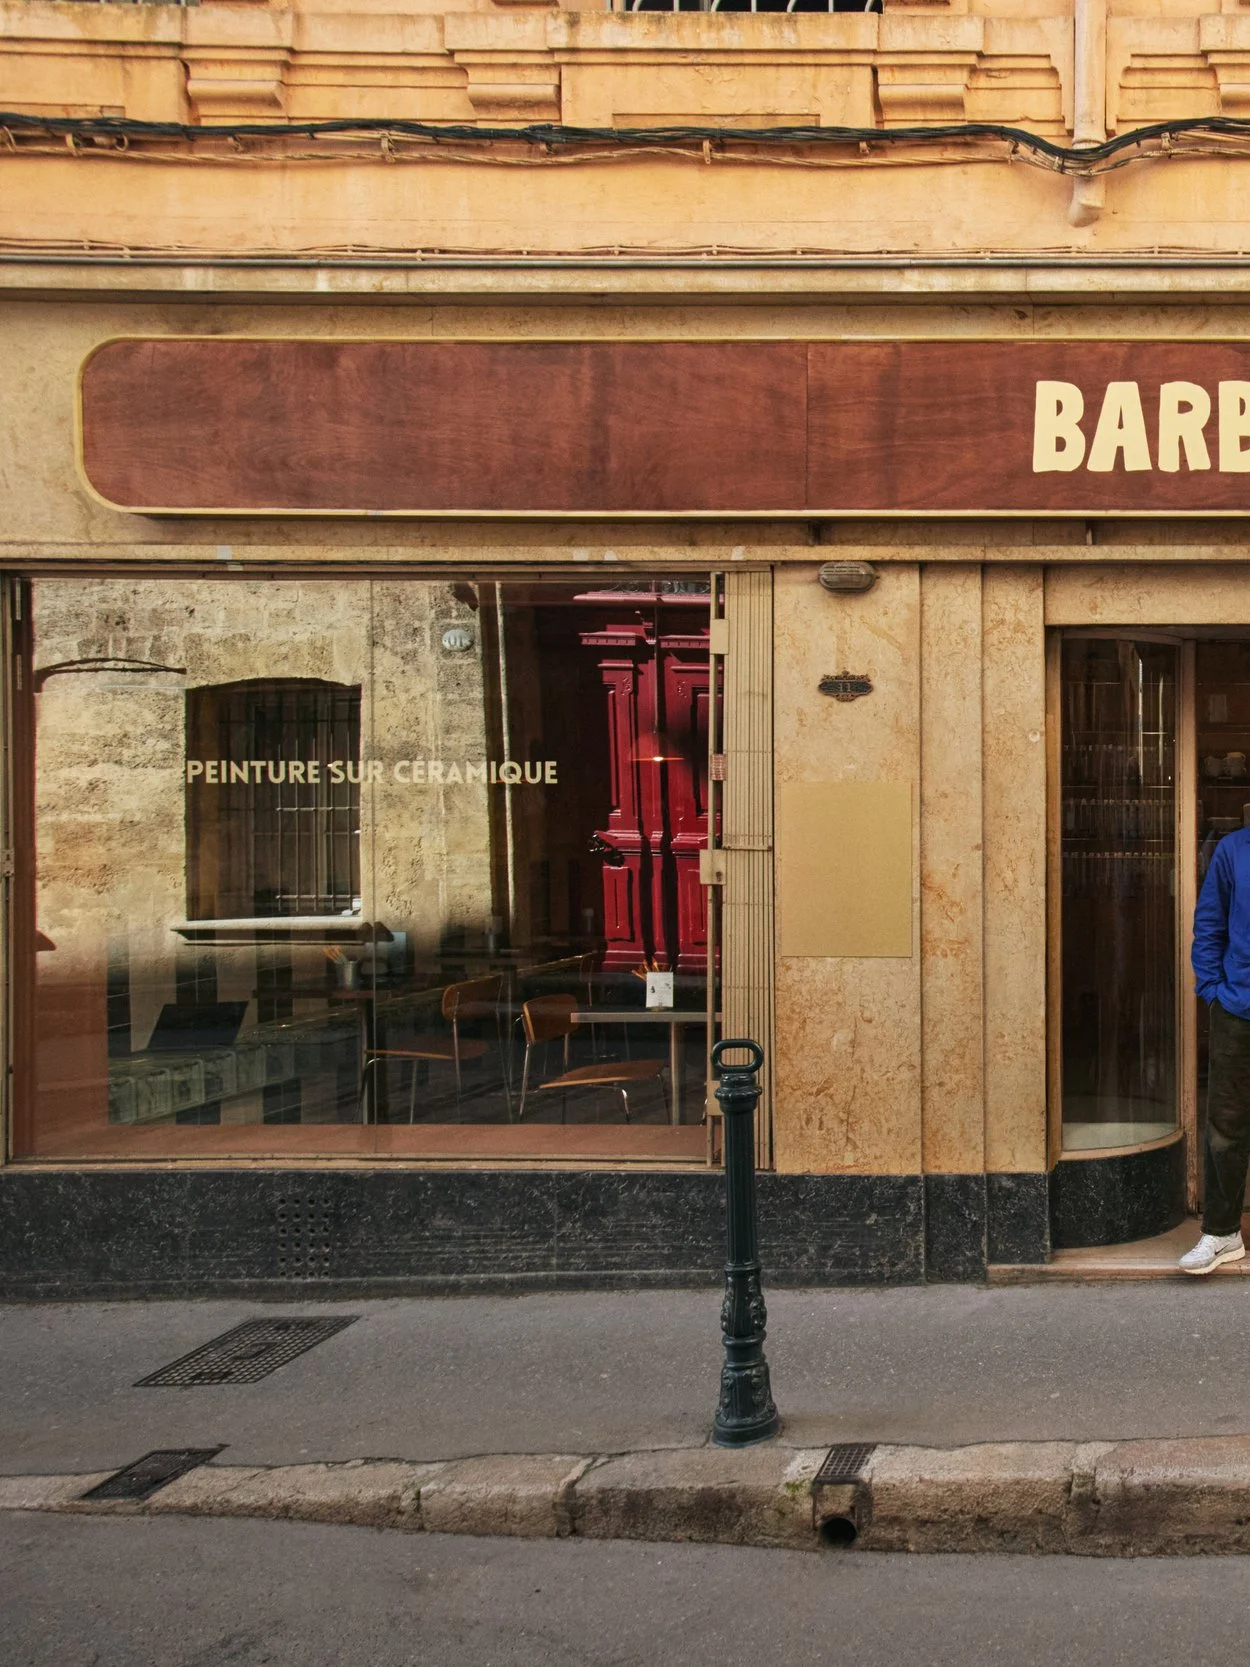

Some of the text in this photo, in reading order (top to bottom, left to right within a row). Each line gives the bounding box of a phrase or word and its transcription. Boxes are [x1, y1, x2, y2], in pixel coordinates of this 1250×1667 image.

[186, 755, 558, 784] PEINTURE SUR CÉRAMIQUE
